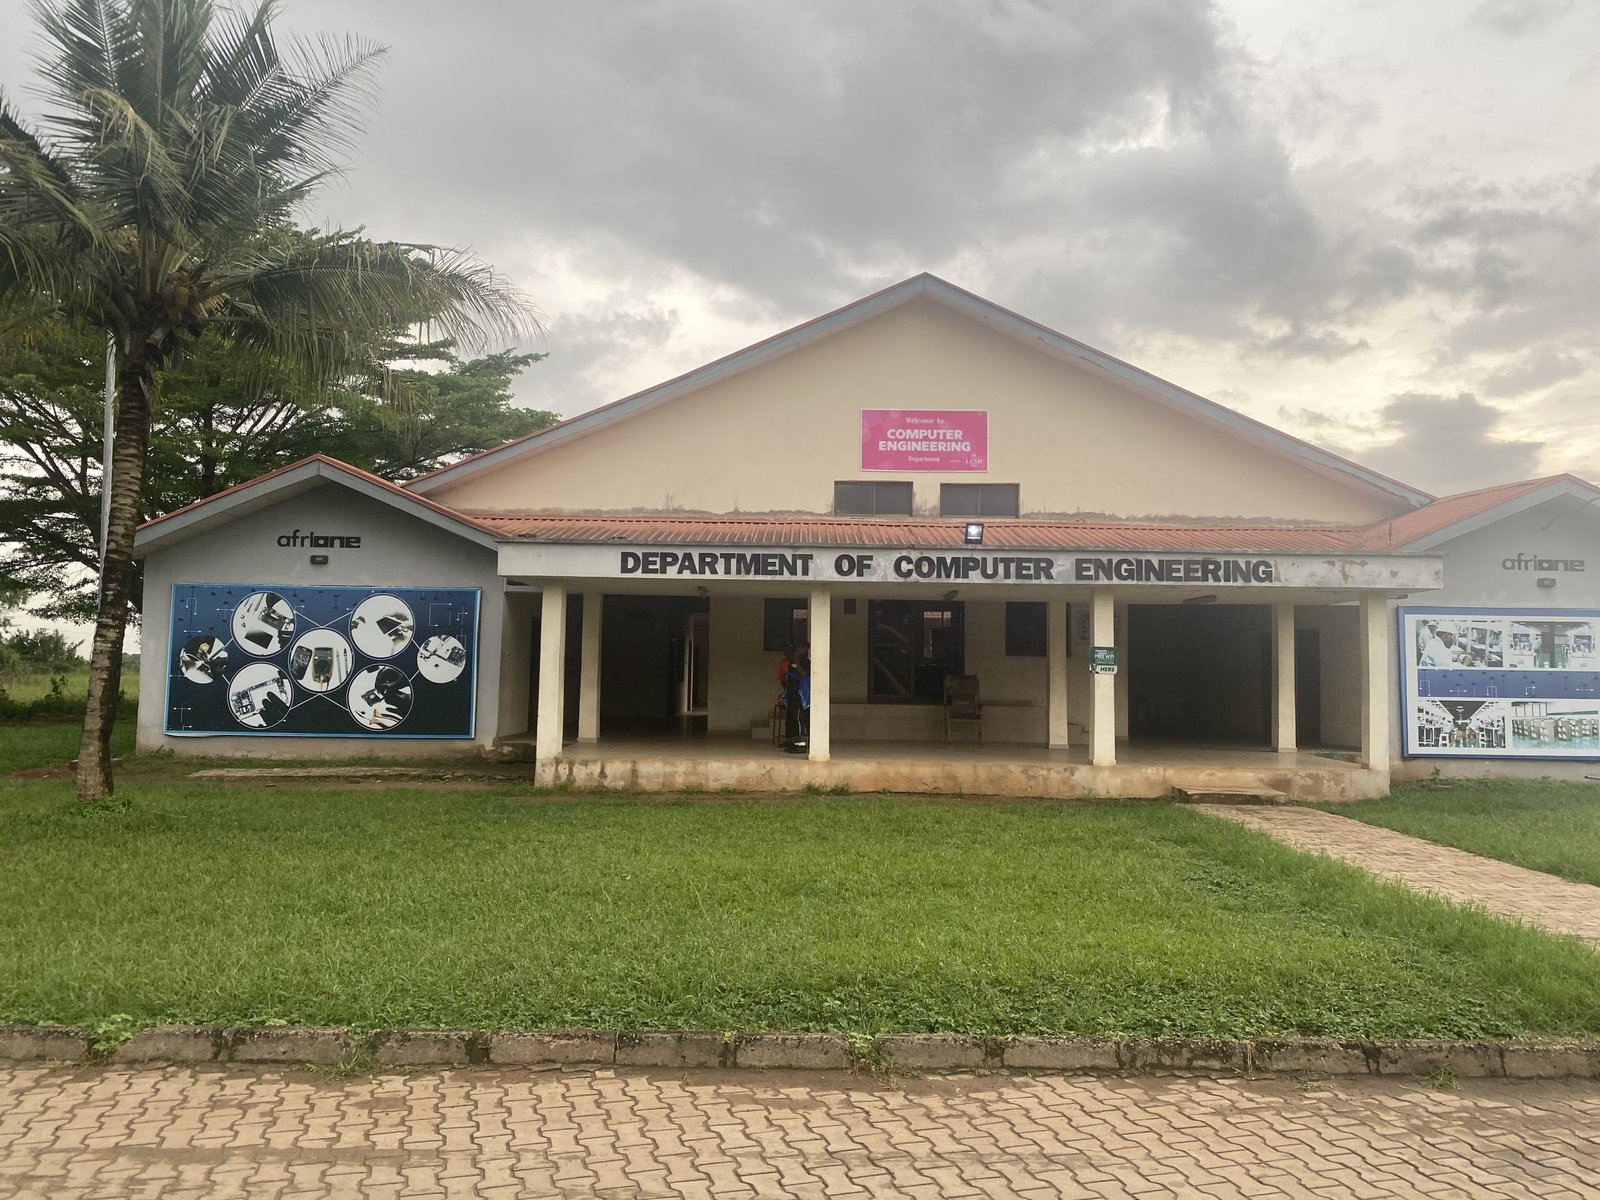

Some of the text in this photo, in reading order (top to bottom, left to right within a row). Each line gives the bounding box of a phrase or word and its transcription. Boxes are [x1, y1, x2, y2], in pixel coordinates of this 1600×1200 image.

[887, 429, 963, 439] COMPUTER
[879, 441, 971, 452] ENGINEERING
[277, 529, 361, 548] afrione
[620, 551, 1273, 583] DEPARTMENT OF COMPUTER ENGINEERING
[1502, 553, 1584, 571] afrione
